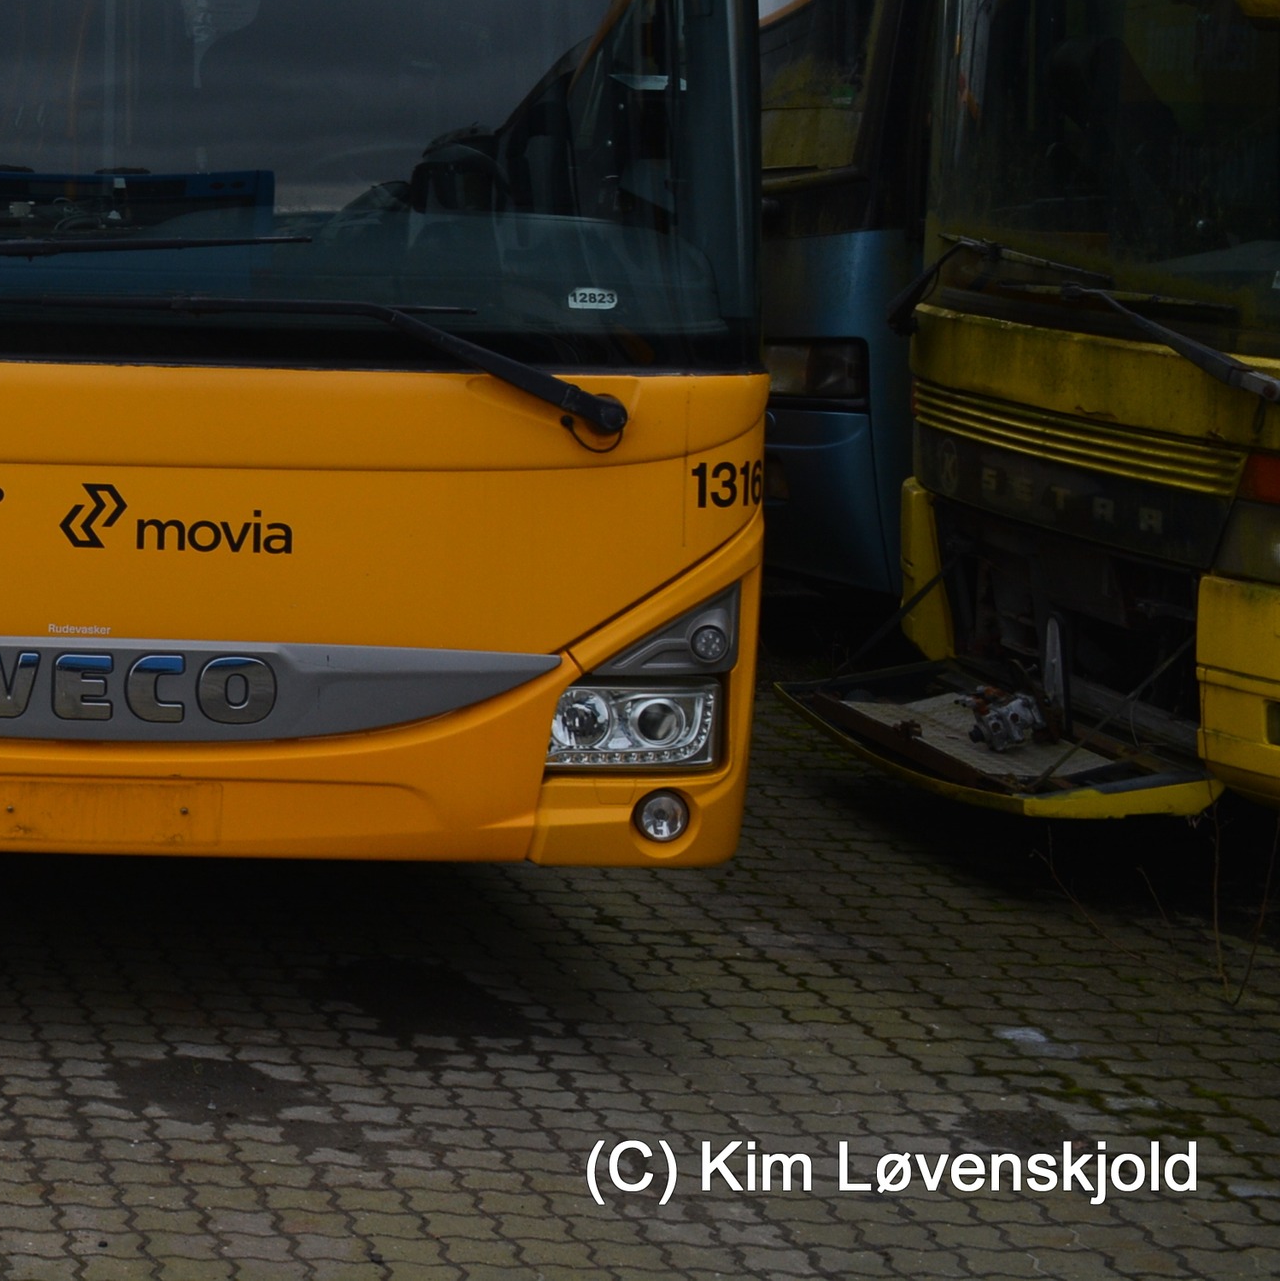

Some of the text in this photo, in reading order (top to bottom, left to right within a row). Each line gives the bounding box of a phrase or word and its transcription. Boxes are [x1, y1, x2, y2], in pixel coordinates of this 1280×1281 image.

[571, 292, 615, 304] 12823
[691, 459, 763, 508] 1316
[981, 466, 1164, 535] SETRA
[136, 509, 293, 554] movia
[47, 623, 112, 635] Rudevasker
